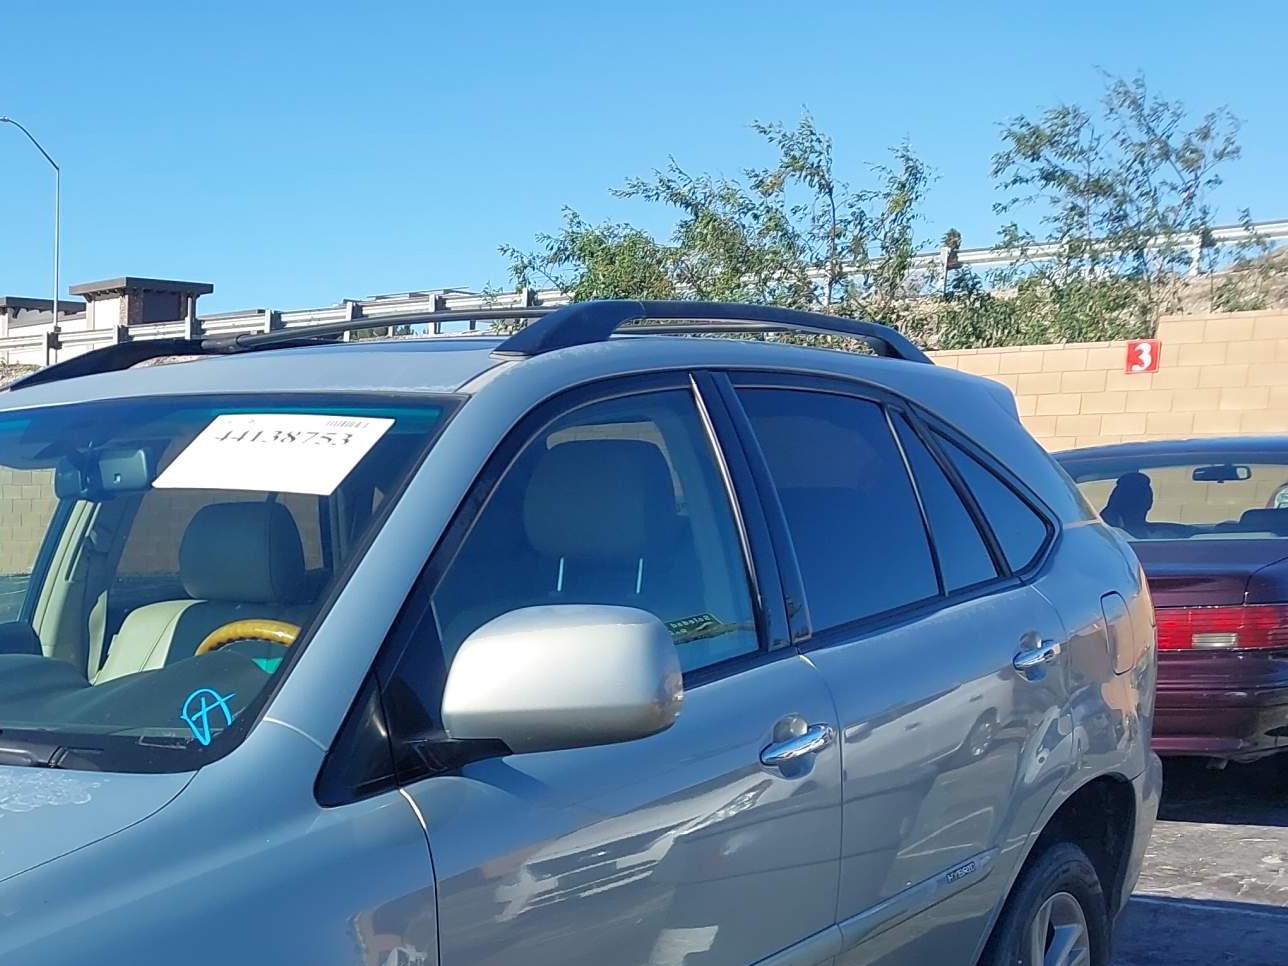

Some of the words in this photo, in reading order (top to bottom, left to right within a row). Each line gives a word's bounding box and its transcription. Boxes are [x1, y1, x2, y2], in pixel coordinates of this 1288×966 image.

[1131, 342, 1152, 371] 3
[215, 429, 353, 446] 44138753
[946, 861, 976, 883] HYBRID
